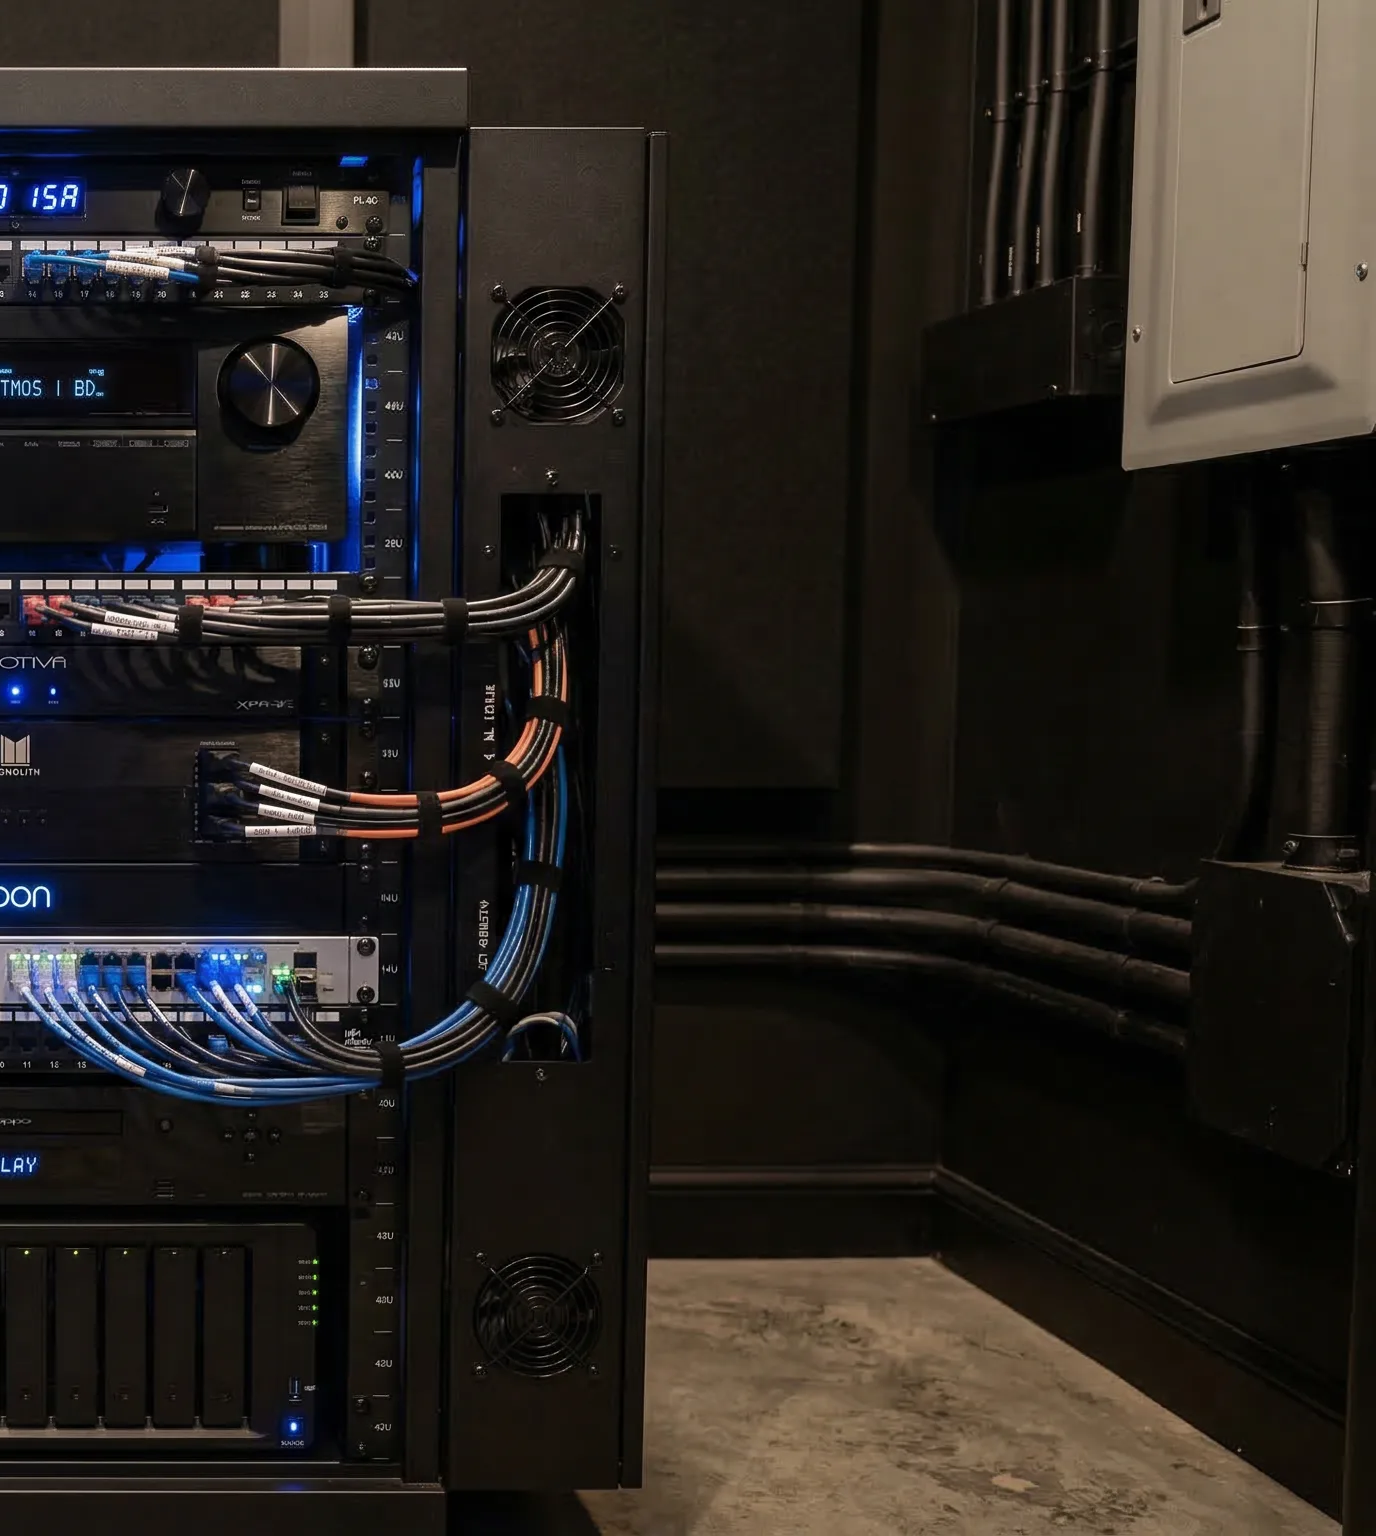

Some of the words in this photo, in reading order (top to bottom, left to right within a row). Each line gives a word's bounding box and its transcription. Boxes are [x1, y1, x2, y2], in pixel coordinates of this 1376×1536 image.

[31, 184, 79, 210] 15A
[74, 379, 95, 397] BD
[22, 1060, 31, 1069] 11
